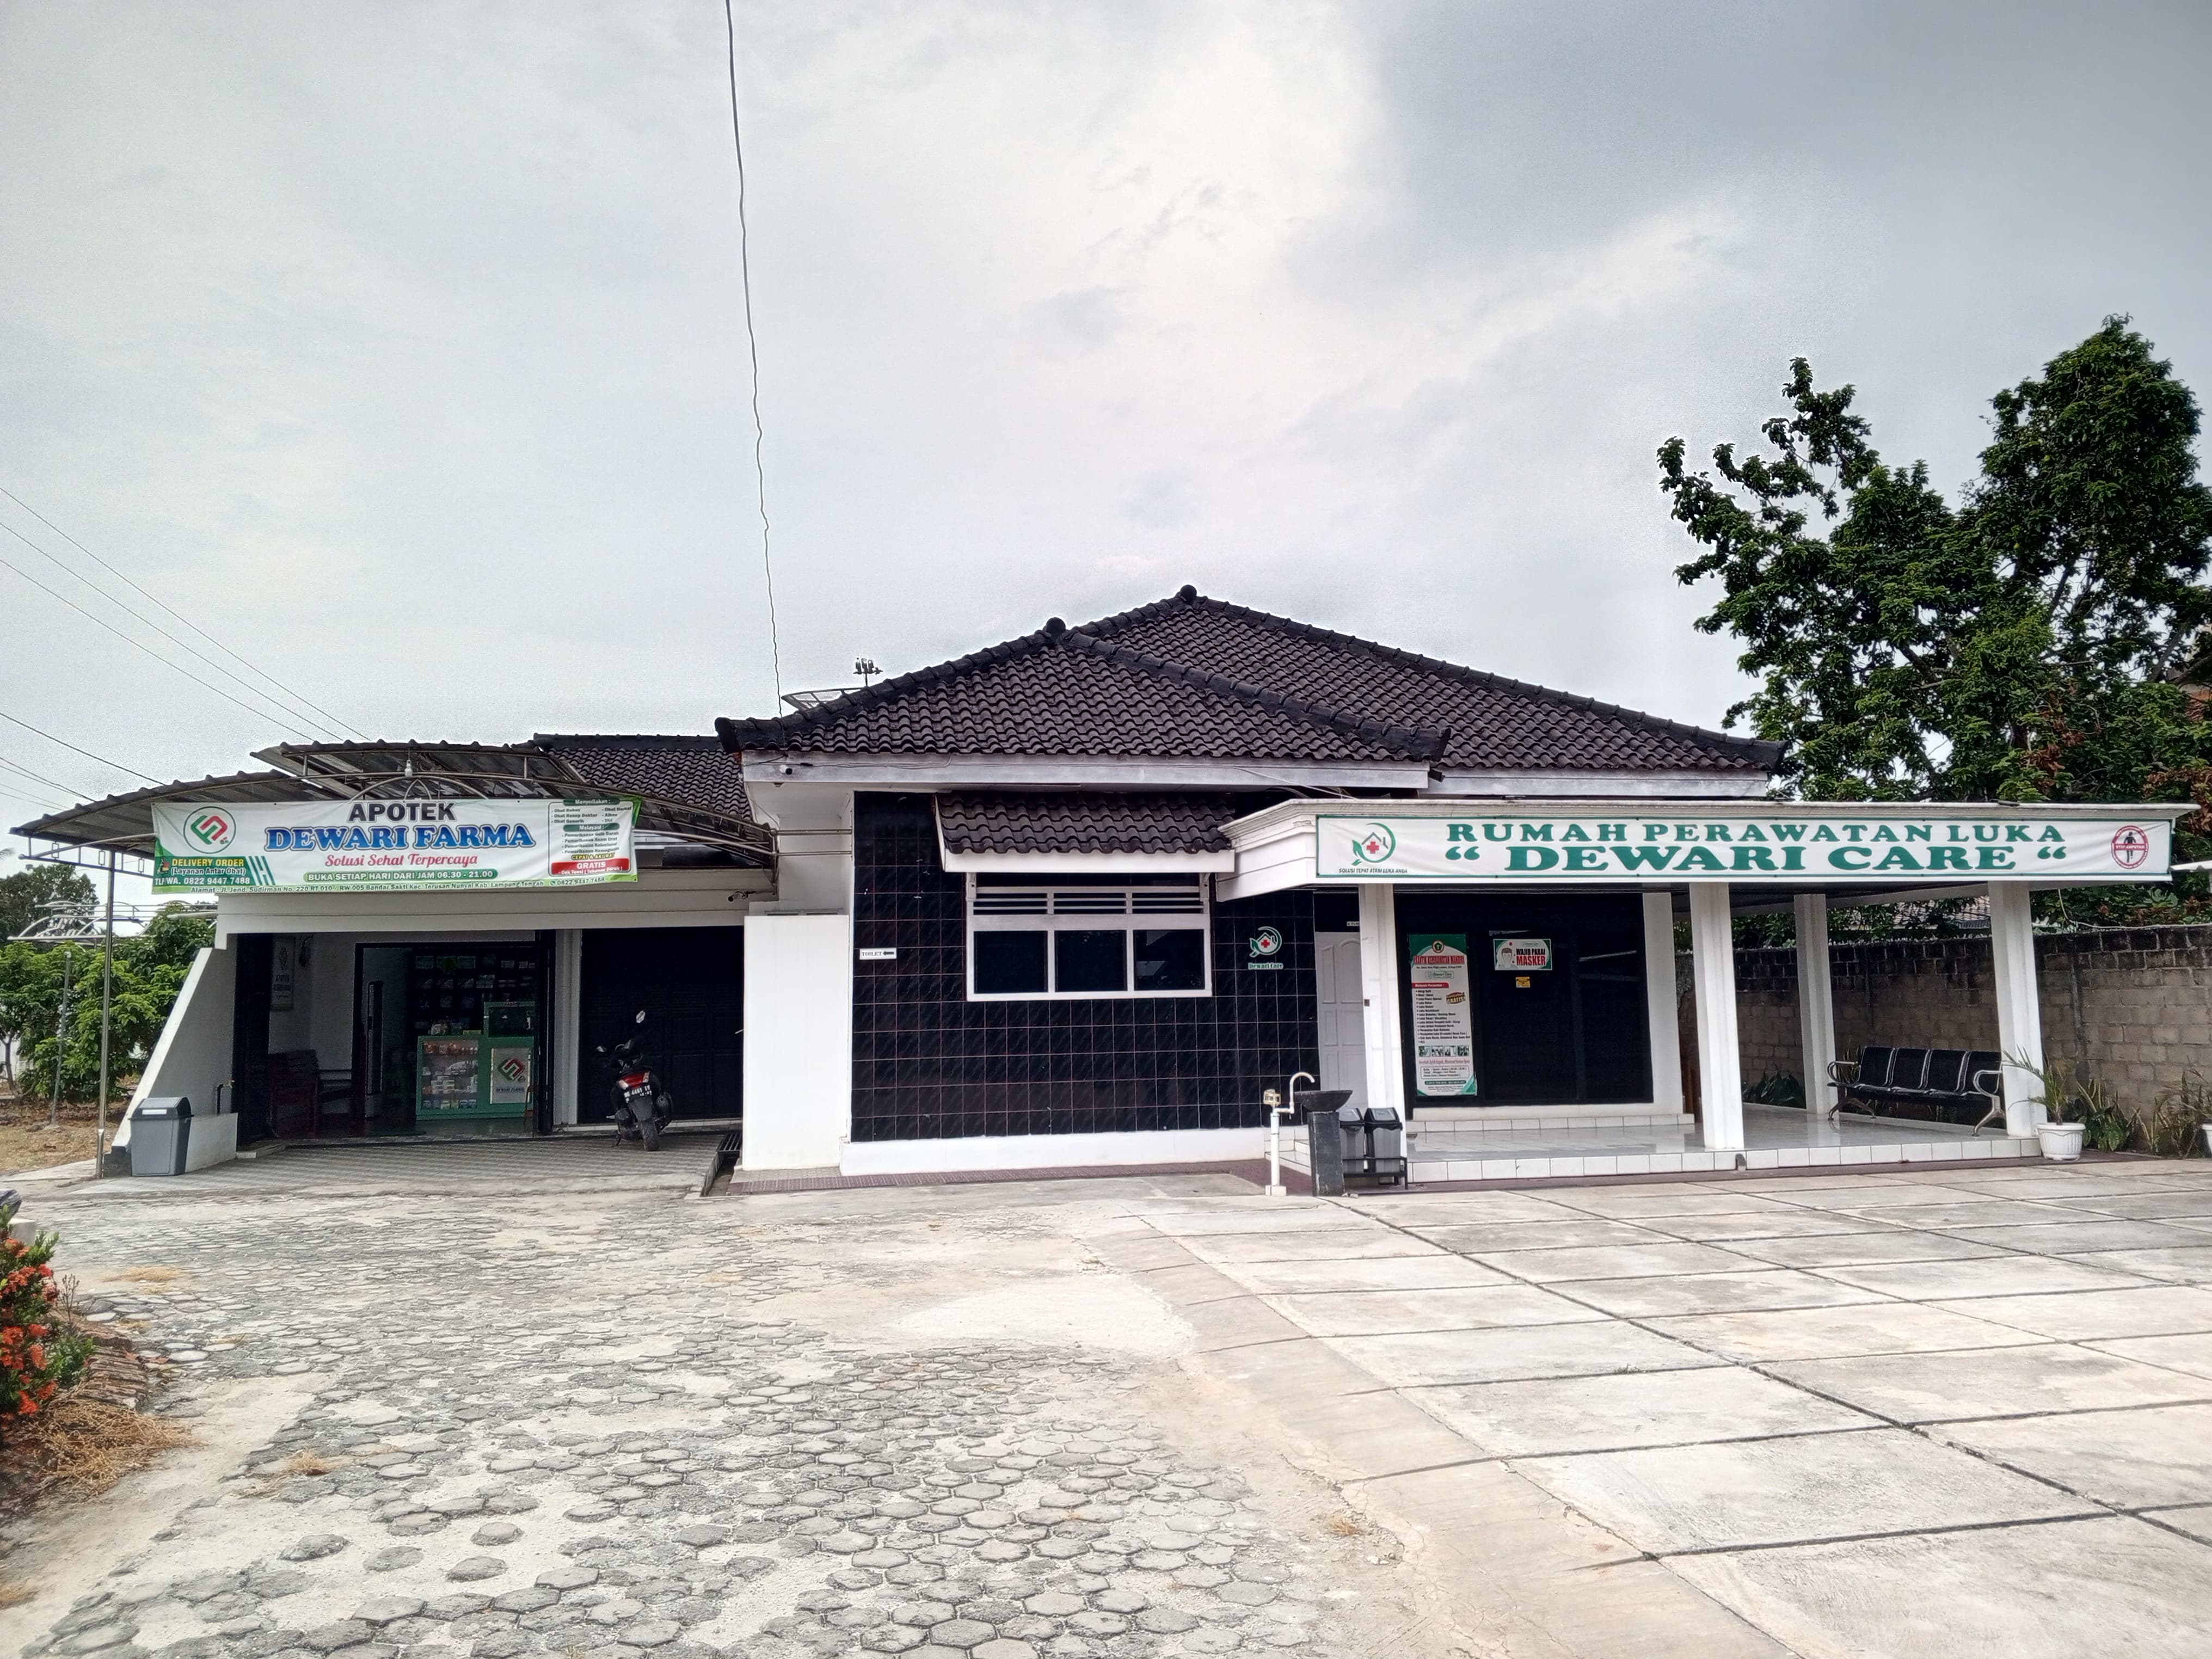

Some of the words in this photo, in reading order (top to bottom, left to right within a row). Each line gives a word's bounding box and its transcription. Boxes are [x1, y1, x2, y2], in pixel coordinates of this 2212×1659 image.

[348, 802, 456, 822] APOTEK
[265, 826, 409, 851] DEWARI
[414, 824, 536, 849] FARMA
[1446, 824, 1627, 841] RUMAH
[1642, 824, 1933, 842] PERAWATAN
[1946, 825, 2066, 842] LUKA
[171, 858, 213, 867] DELIVERY
[216, 858, 244, 867] ORDER
[325, 855, 365, 867] Solusi
[367, 854, 404, 866] Sehat
[407, 853, 478, 868] Terpercaya
[1504, 846, 1807, 871] DEWARI
[1828, 846, 2016, 870] CARE
[171, 867, 205, 875] (Layanan
[1516, 956, 1545, 966] MASKER
